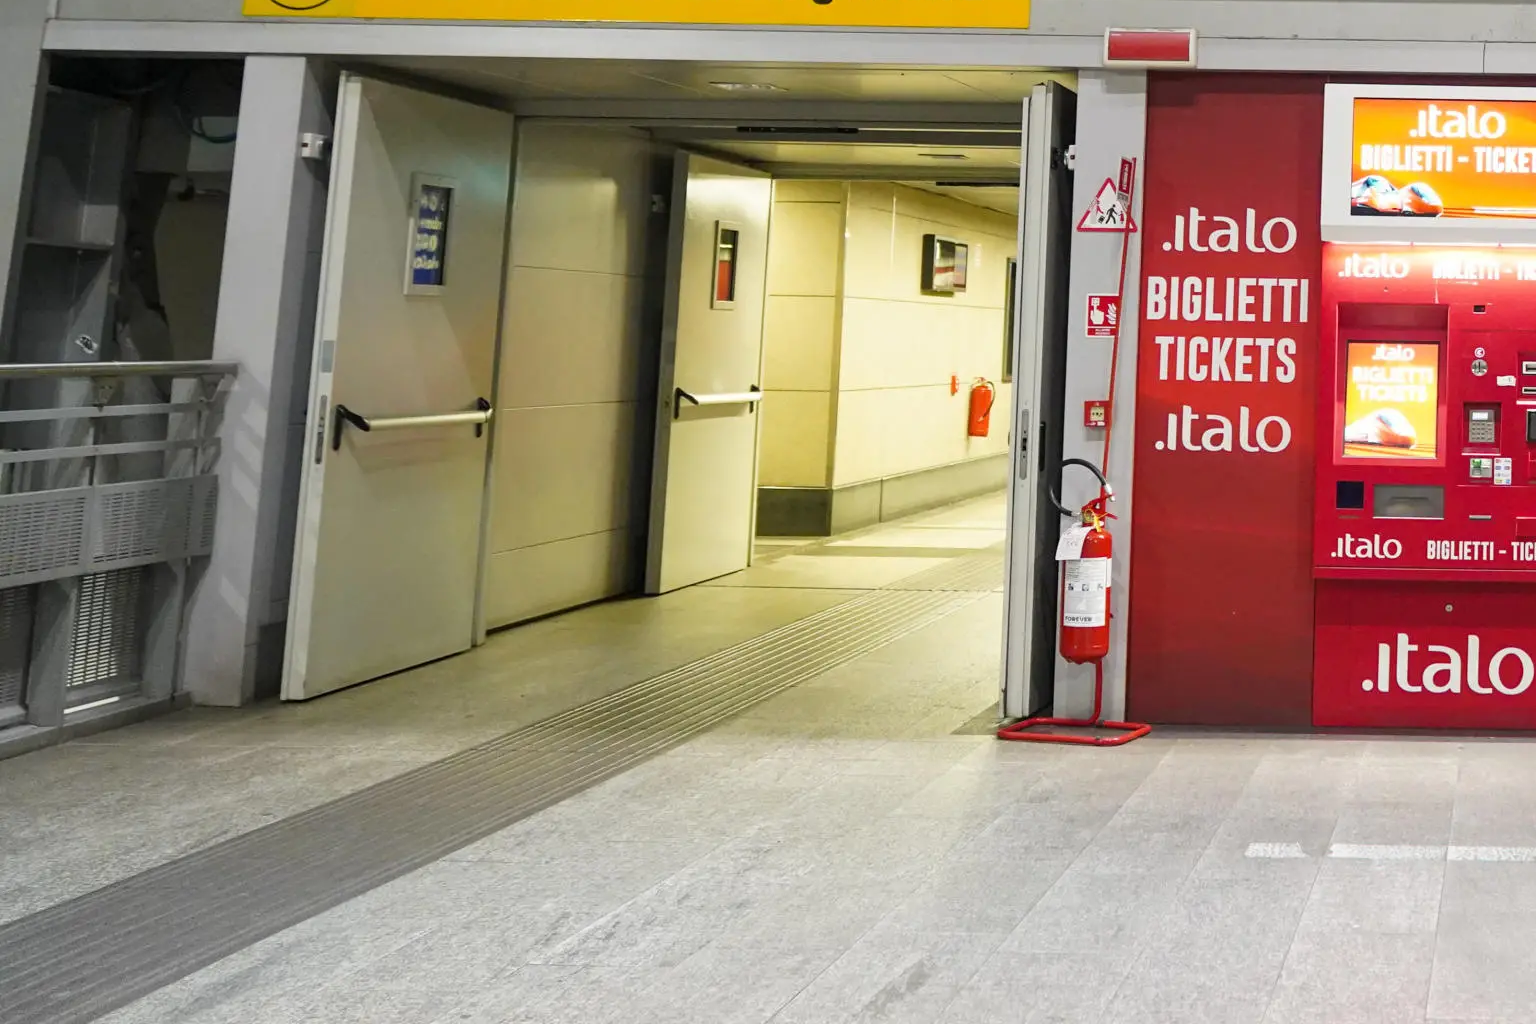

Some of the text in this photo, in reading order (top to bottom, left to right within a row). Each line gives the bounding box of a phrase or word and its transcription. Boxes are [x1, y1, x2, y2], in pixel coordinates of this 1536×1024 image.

[1361, 144, 1453, 171] BIGLIETTI
[1432, 259, 1500, 280] BIGLIETTI
[1146, 276, 1309, 323] BIGLIETTI
[1155, 335, 1297, 383] TICKETS
[1427, 540, 1495, 561] BIGLIETTI
